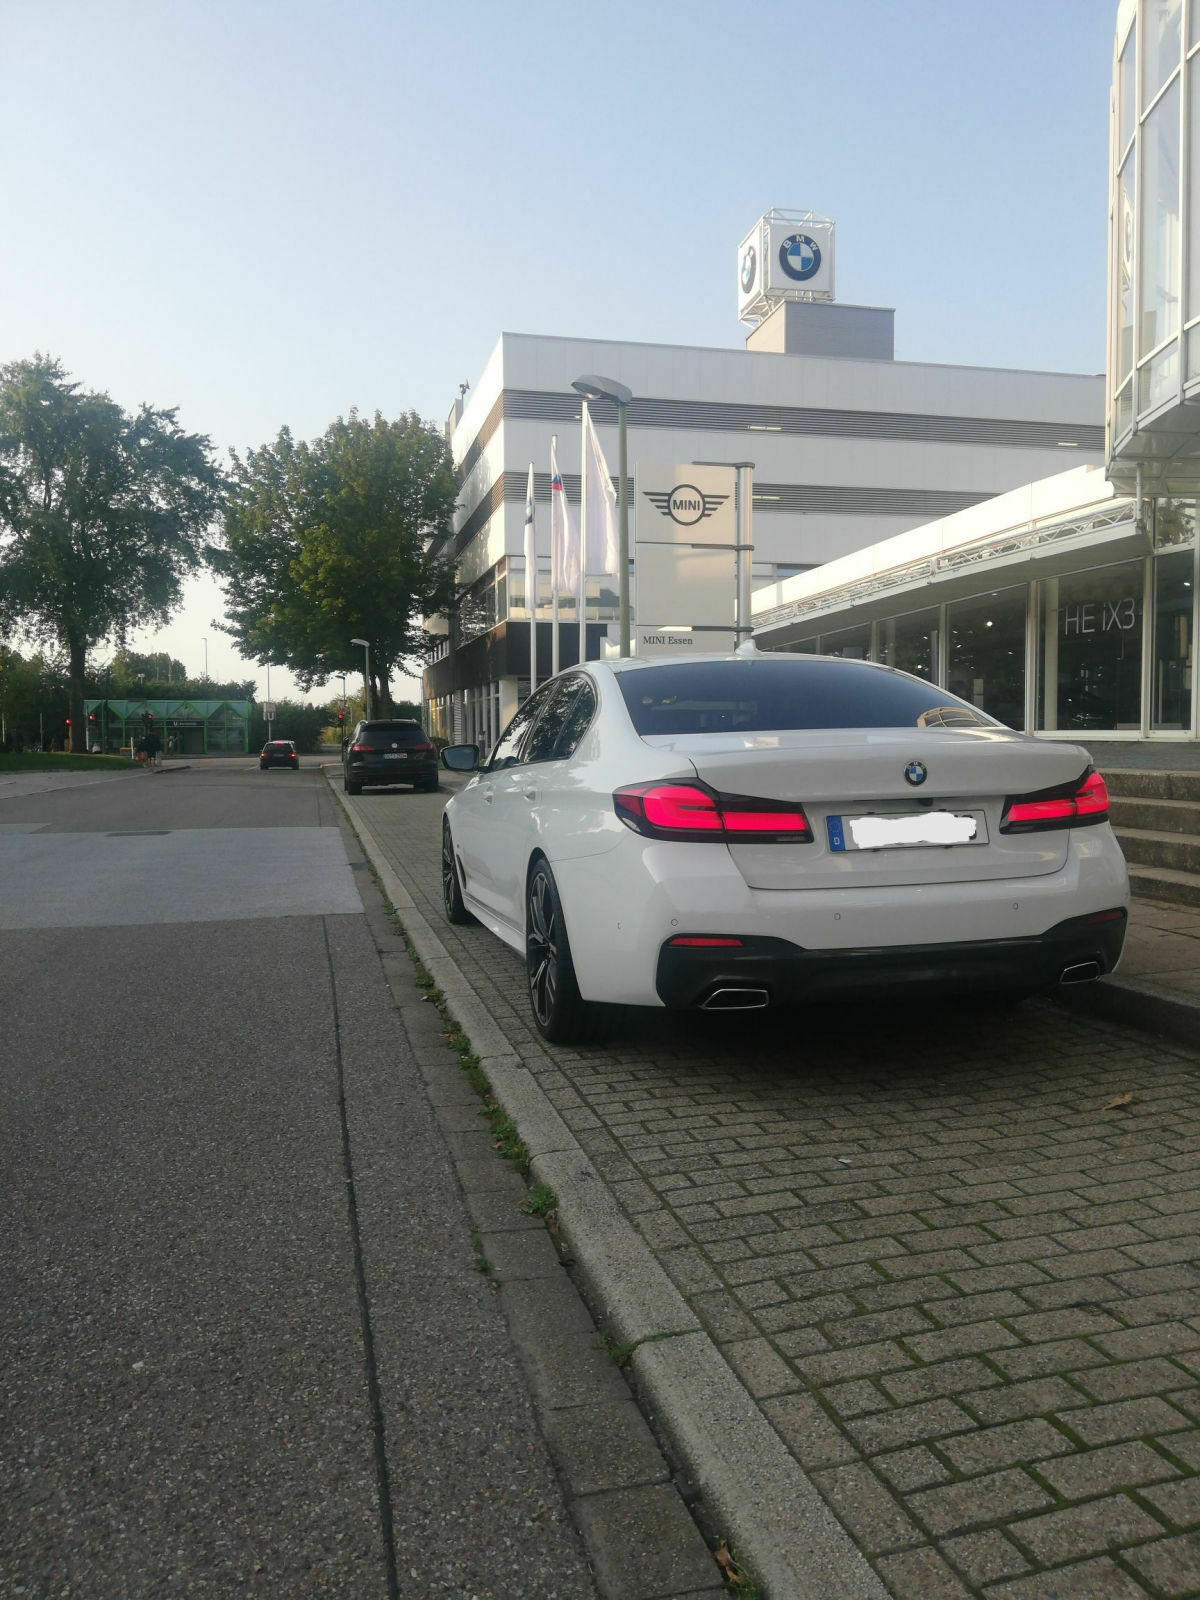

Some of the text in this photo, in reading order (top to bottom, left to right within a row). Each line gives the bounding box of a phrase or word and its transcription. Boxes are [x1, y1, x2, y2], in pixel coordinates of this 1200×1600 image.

[783, 235, 819, 251] BMW
[672, 499, 700, 511] MINI
[1102, 597, 1136, 631] iX3
[643, 635, 693, 646] MINI Essen
[833, 836, 840, 846] D
